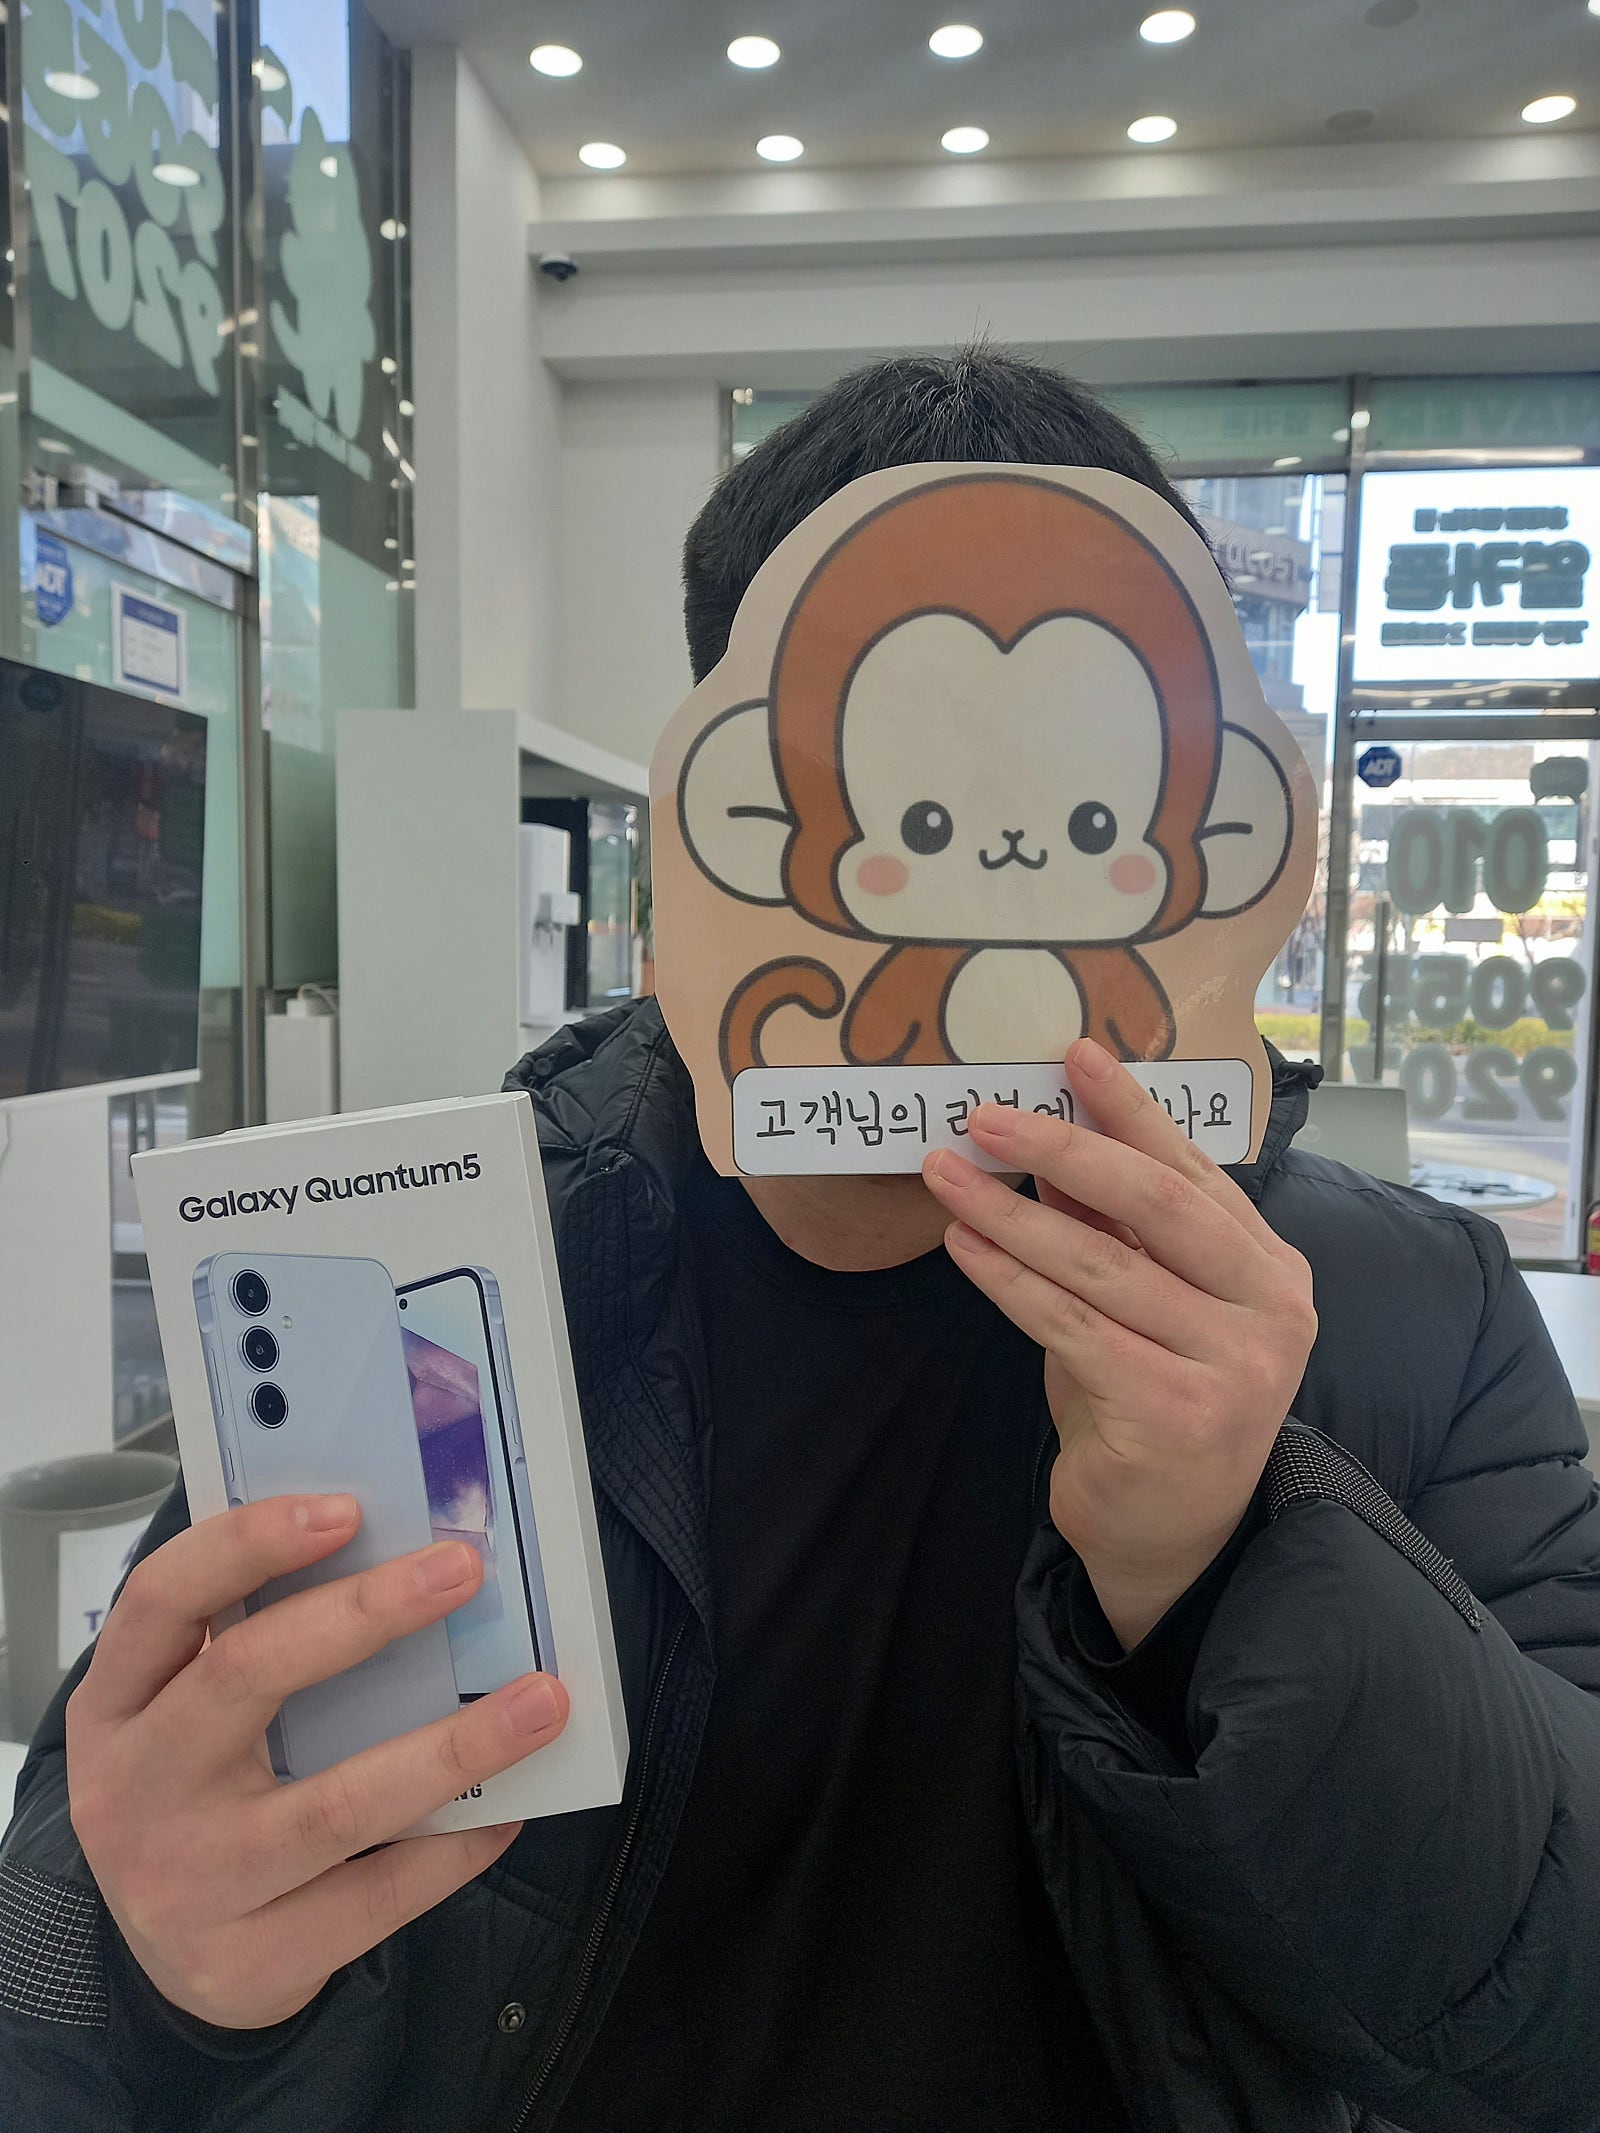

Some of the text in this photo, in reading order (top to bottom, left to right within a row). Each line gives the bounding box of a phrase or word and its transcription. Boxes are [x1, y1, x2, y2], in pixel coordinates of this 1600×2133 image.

[1364, 758, 1397, 776] ADT
[756, 1089, 927, 1147] 고객님의
[178, 1153, 481, 1223] Galaxy Quantum5
